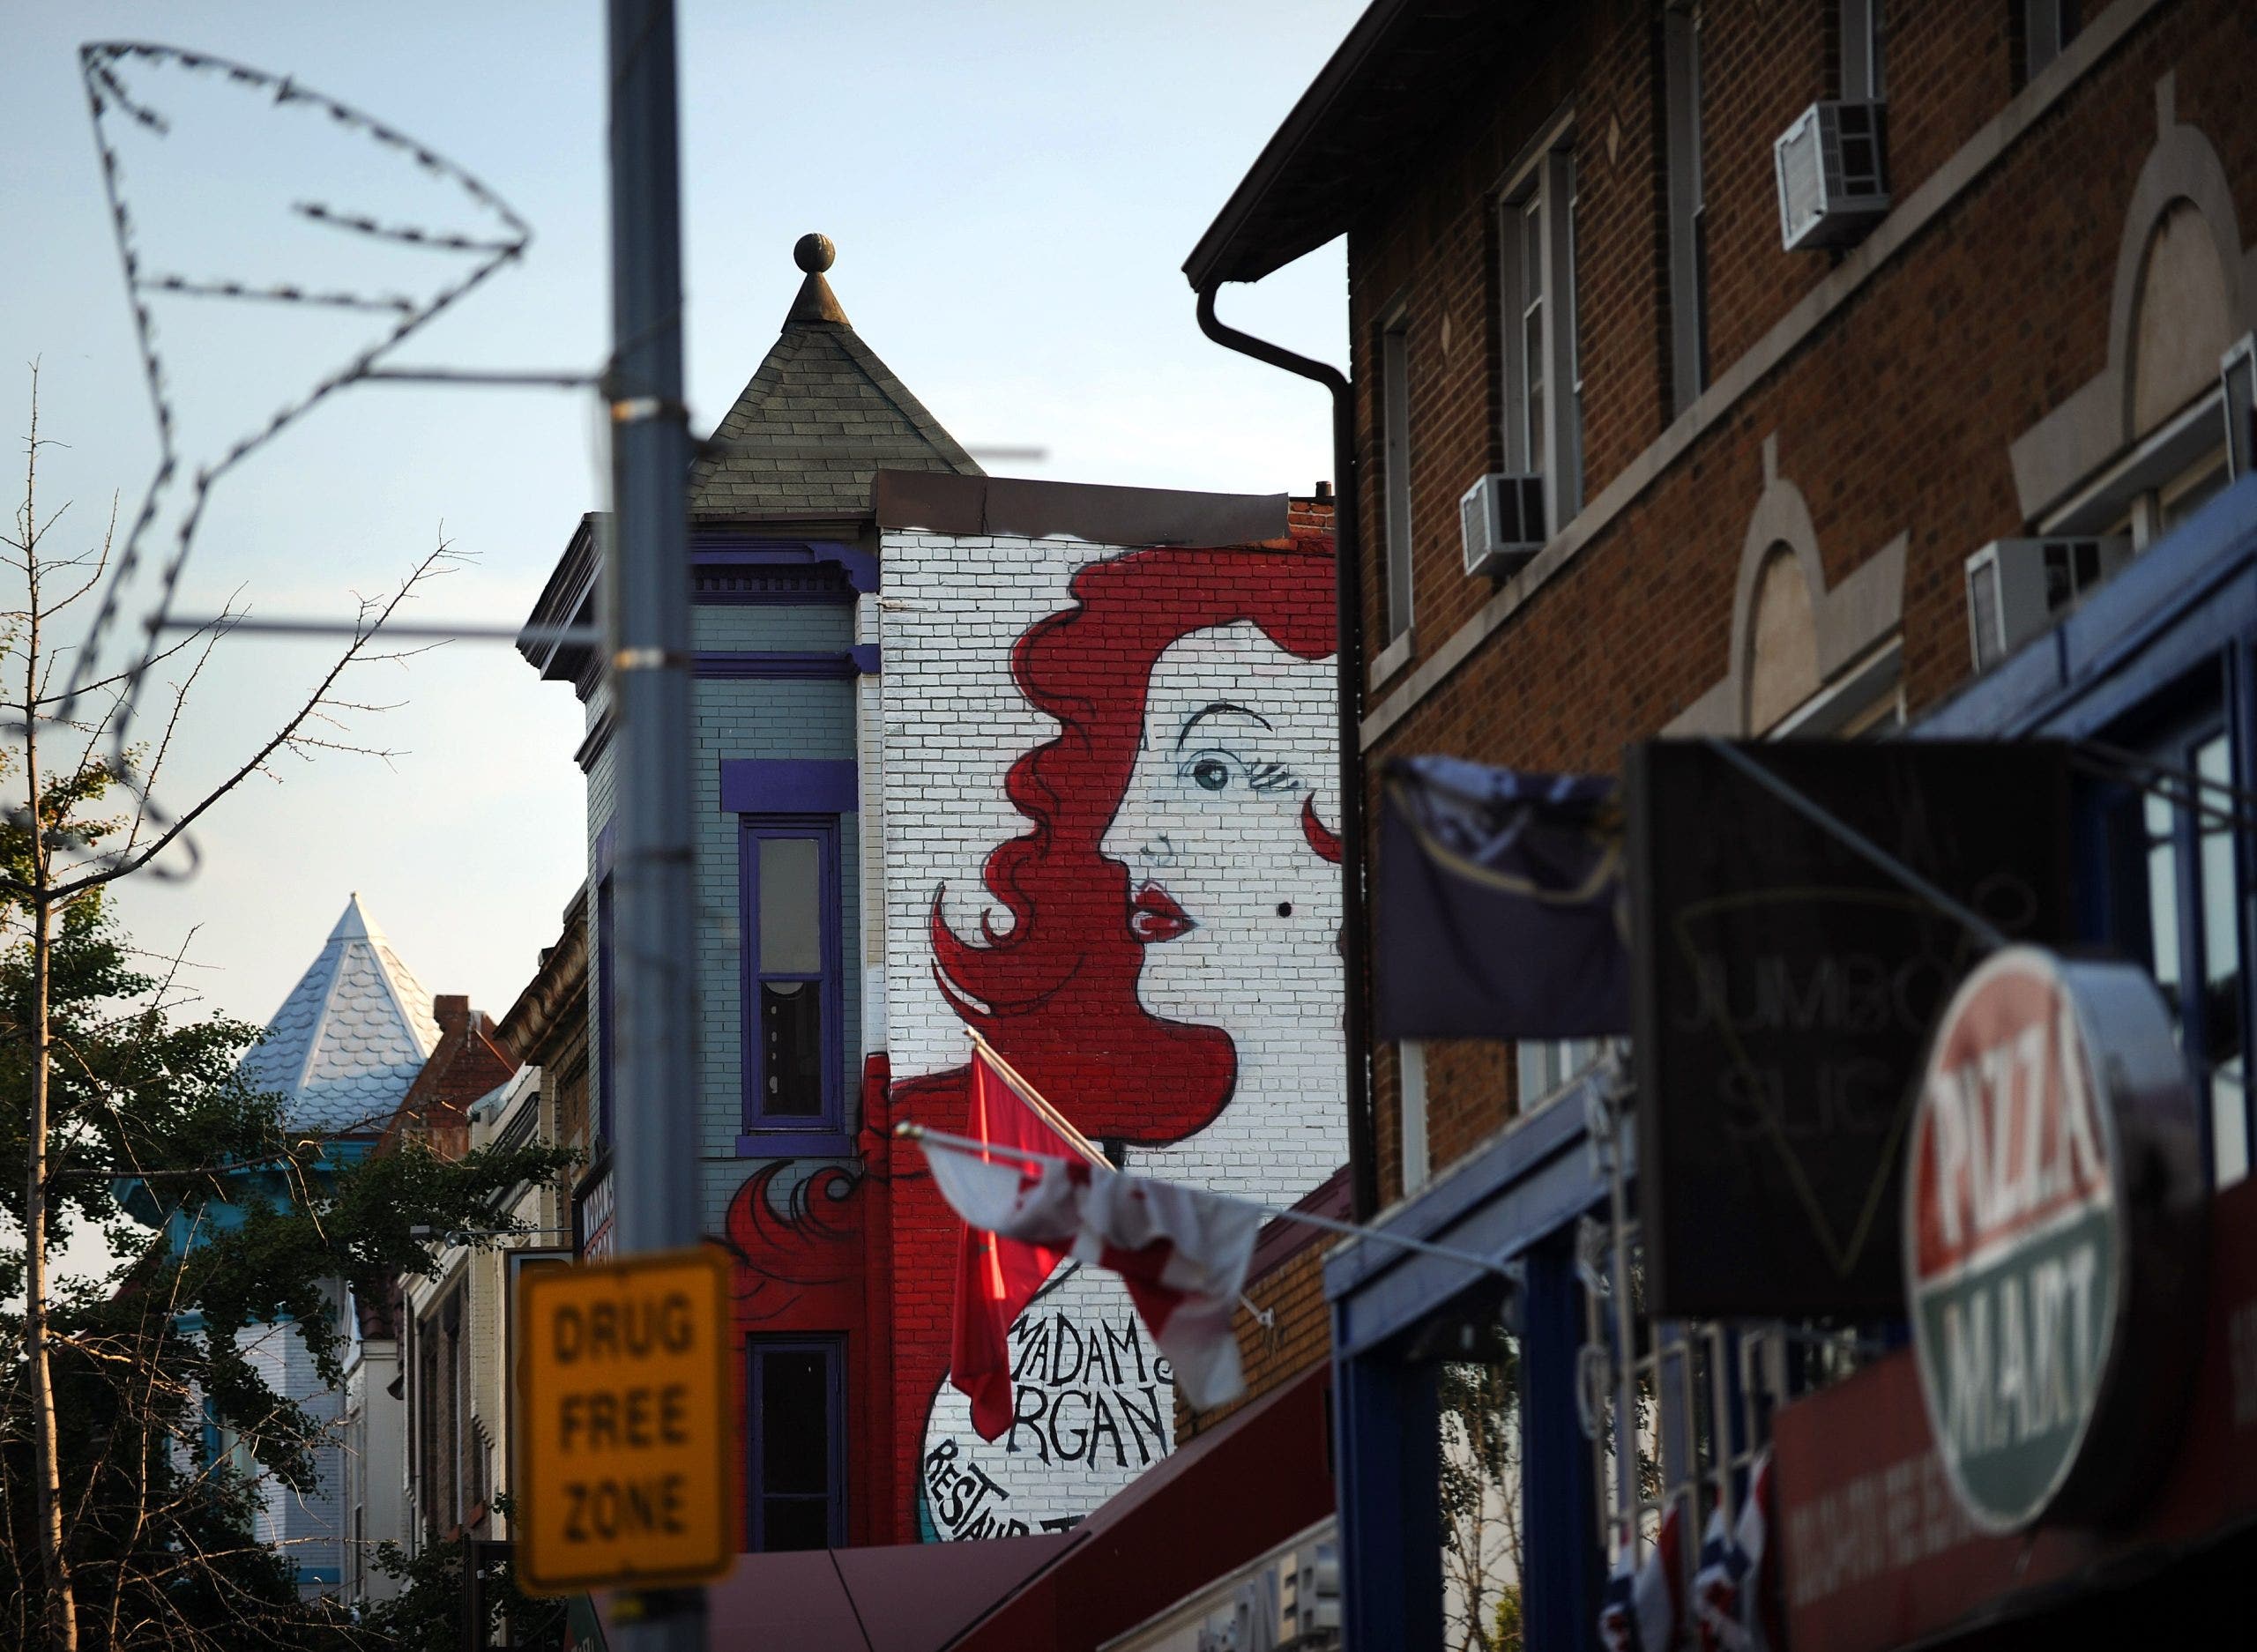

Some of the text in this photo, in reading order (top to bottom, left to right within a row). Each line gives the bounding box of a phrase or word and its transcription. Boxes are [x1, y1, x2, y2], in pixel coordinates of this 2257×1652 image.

[1931, 989, 2107, 1248] PIZZA
[553, 1291, 694, 1365] DRUG
[1943, 1243, 2097, 1456] MART
[558, 1383, 687, 1451] FREE
[969, 1382, 1168, 1470] RGAN
[562, 1473, 684, 1544] ZONE
